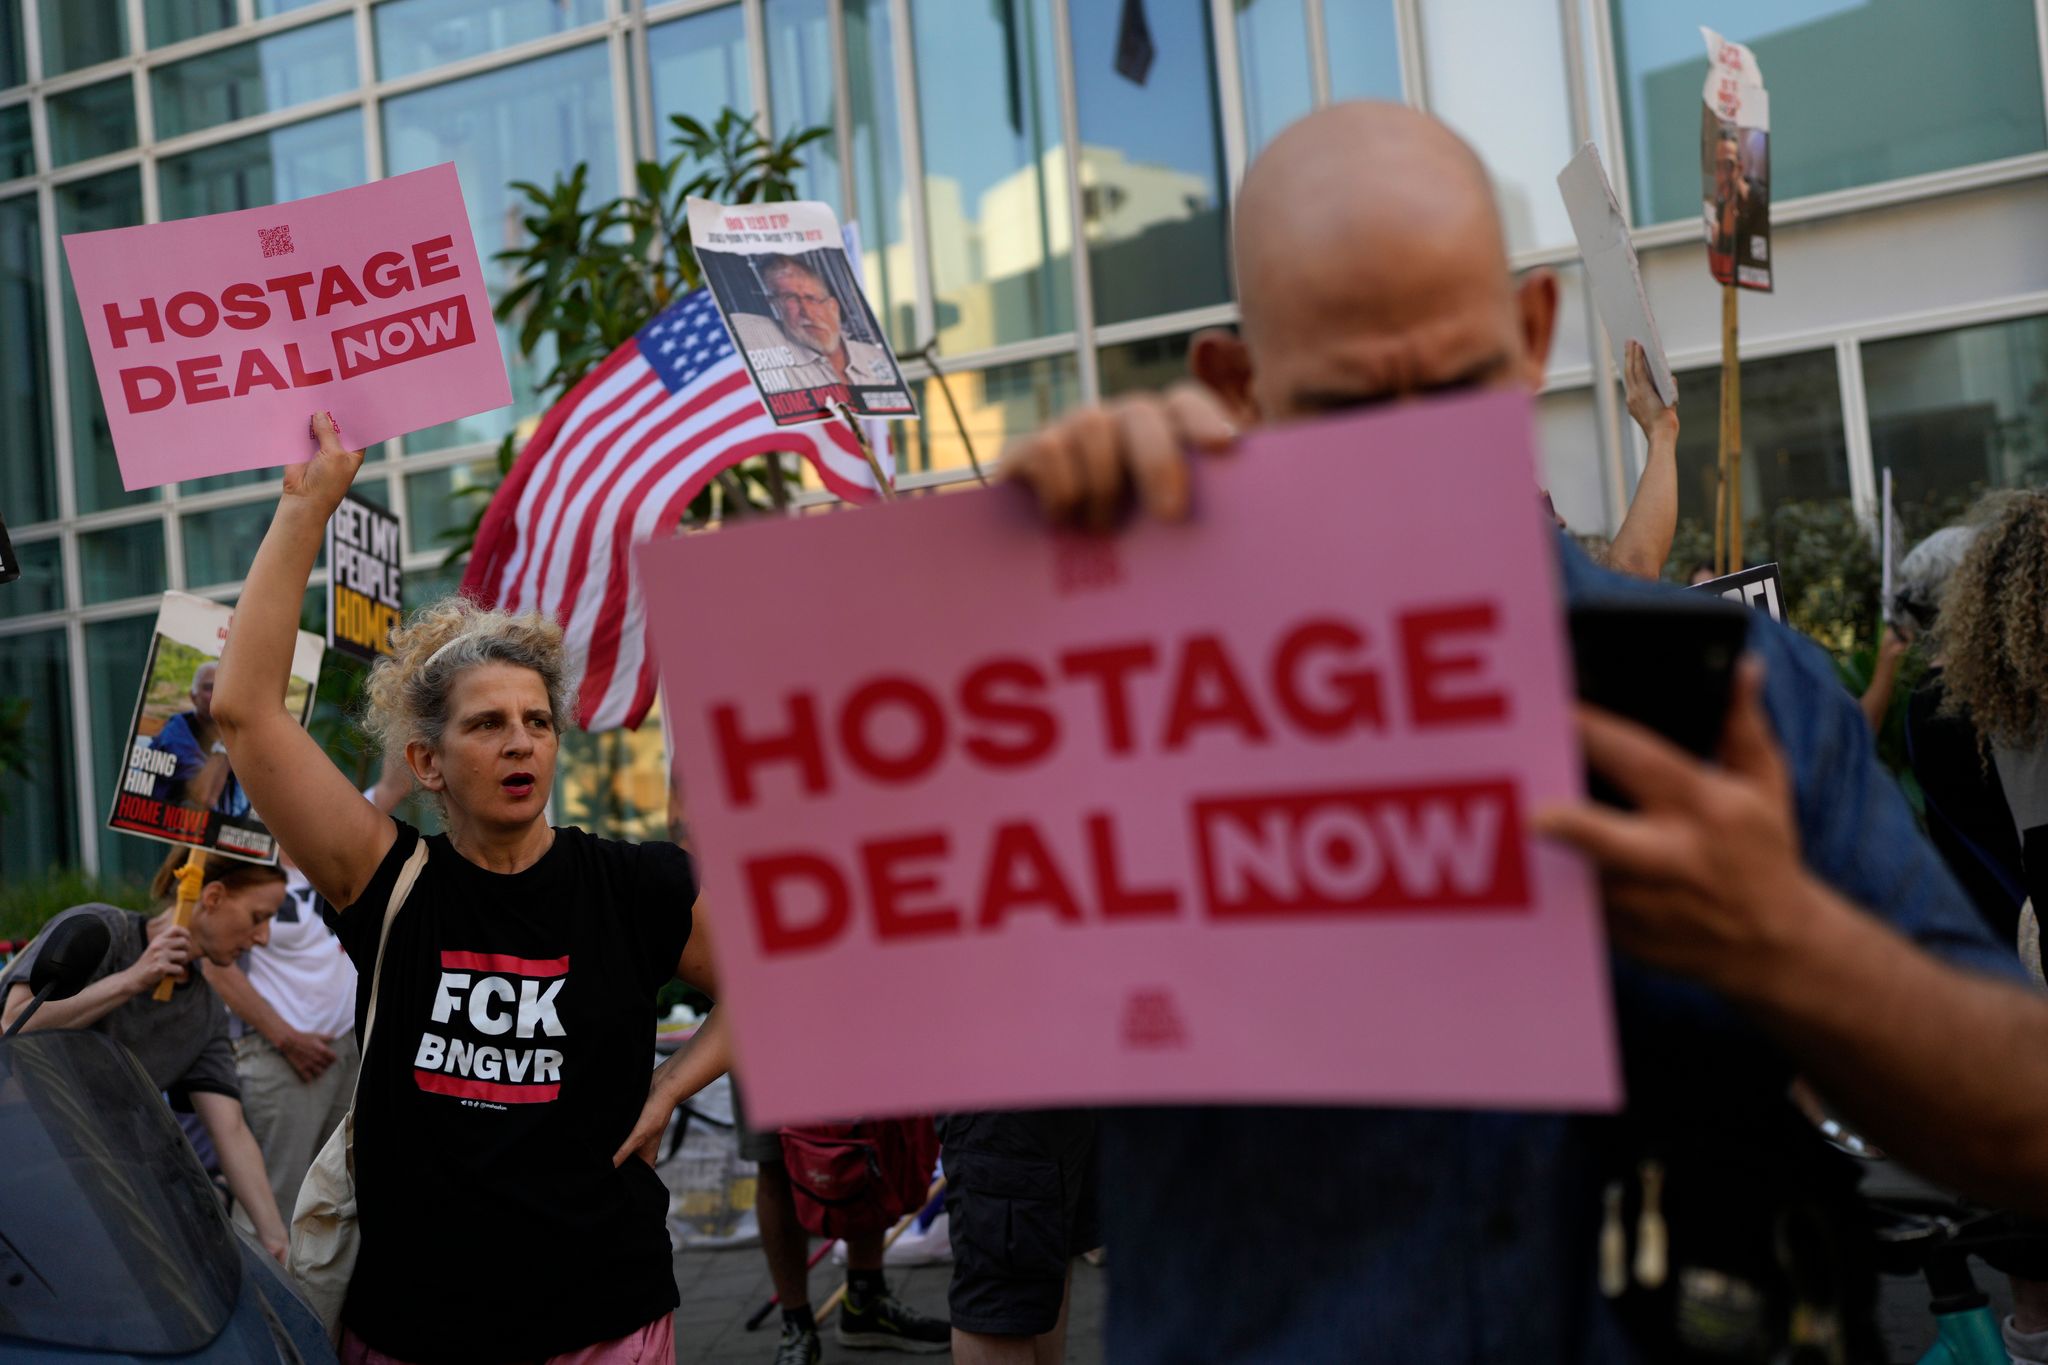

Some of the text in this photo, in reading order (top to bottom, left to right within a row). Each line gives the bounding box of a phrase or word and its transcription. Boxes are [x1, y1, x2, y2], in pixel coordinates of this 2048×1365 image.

[102, 234, 461, 349] HOSTAGE
[118, 305, 459, 414] DEAL NOW
[747, 346, 795, 371] BRING
[757, 368, 792, 394] HIM
[768, 389, 815, 417] HOME
[335, 497, 399, 565] GET MY
[335, 542, 402, 609] PEOPLE
[708, 602, 1513, 807] HOSTAGE
[124, 769, 155, 797] HIM
[130, 746, 177, 777] BRING
[118, 793, 209, 835] HOME NOW!
[743, 796, 1502, 957] DEAL NOW
[430, 971, 568, 1039] FCK
[414, 1032, 564, 1083] BNGVR
